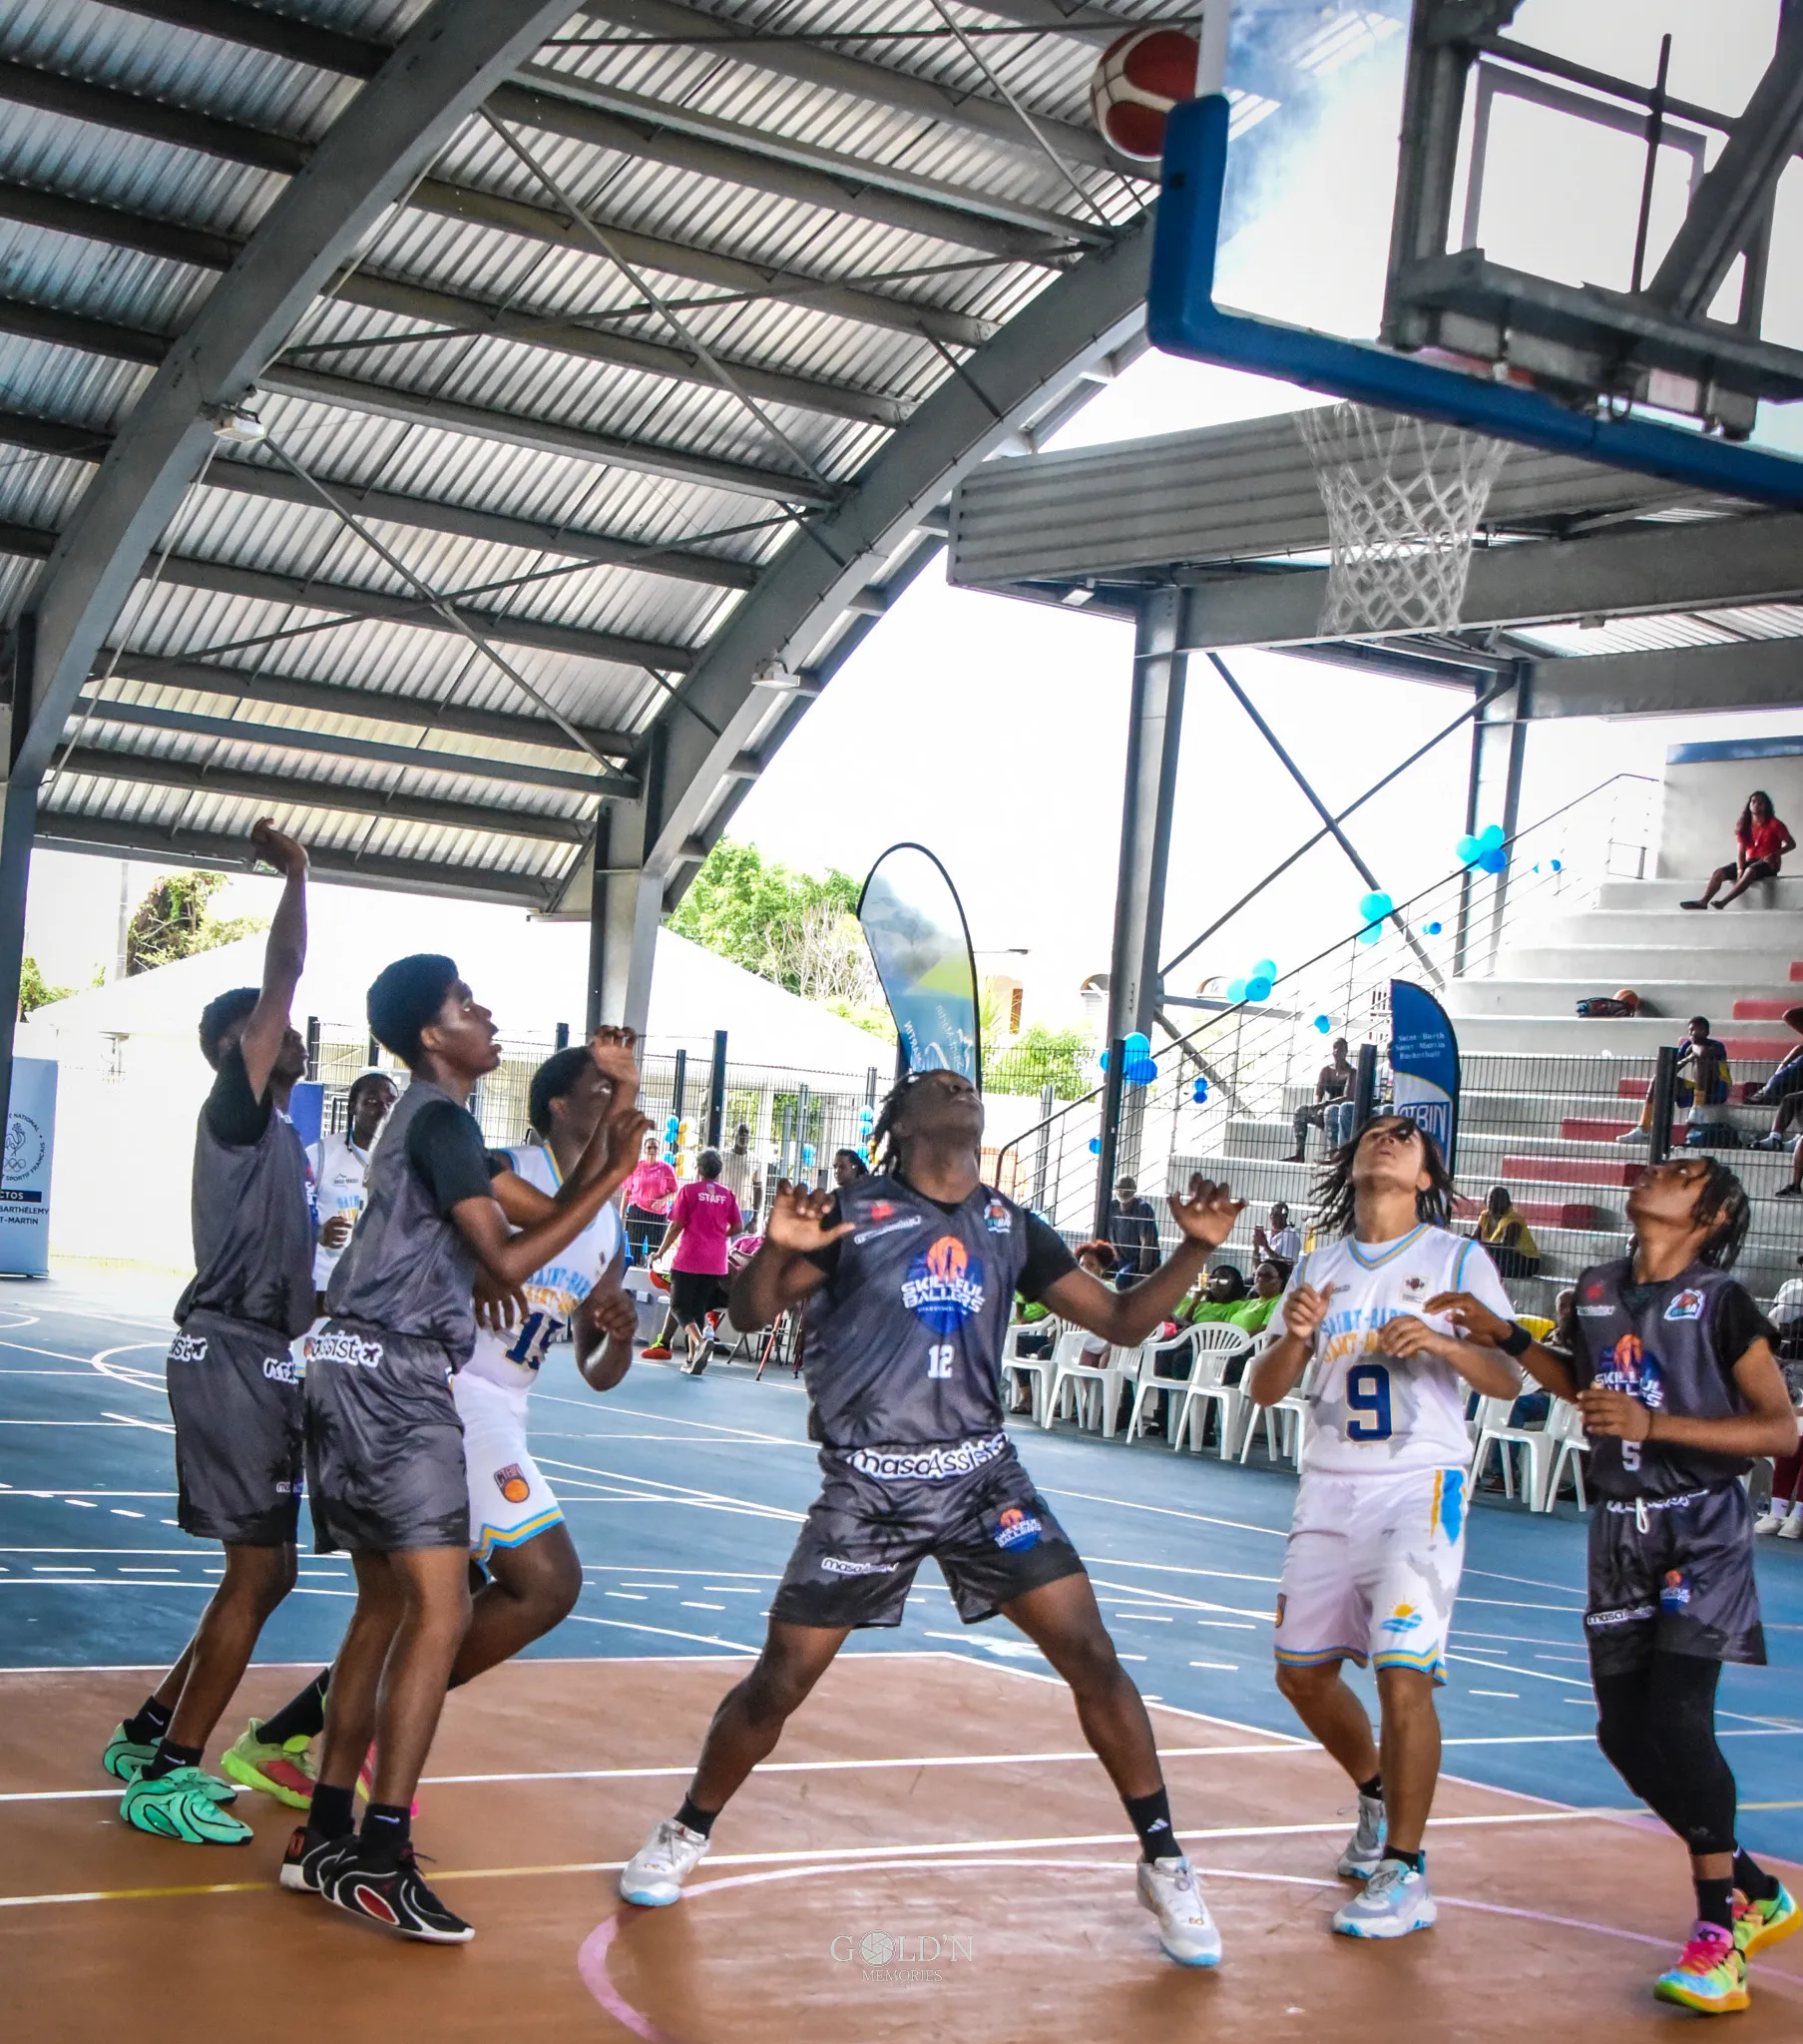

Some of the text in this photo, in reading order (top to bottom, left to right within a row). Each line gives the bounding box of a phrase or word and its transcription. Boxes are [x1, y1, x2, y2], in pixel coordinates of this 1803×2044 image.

[13, 1113, 40, 1133] NATIONAL
[6, 1172, 31, 1182] SPORTIF
[698, 1192, 727, 1205] STAFF
[900, 1275, 984, 1299] SKILLFUL
[902, 1287, 986, 1314] BALLERS
[928, 1345, 954, 1379] 12
[1346, 1363, 1393, 1445] 9
[1620, 1440, 1641, 1472] 5
